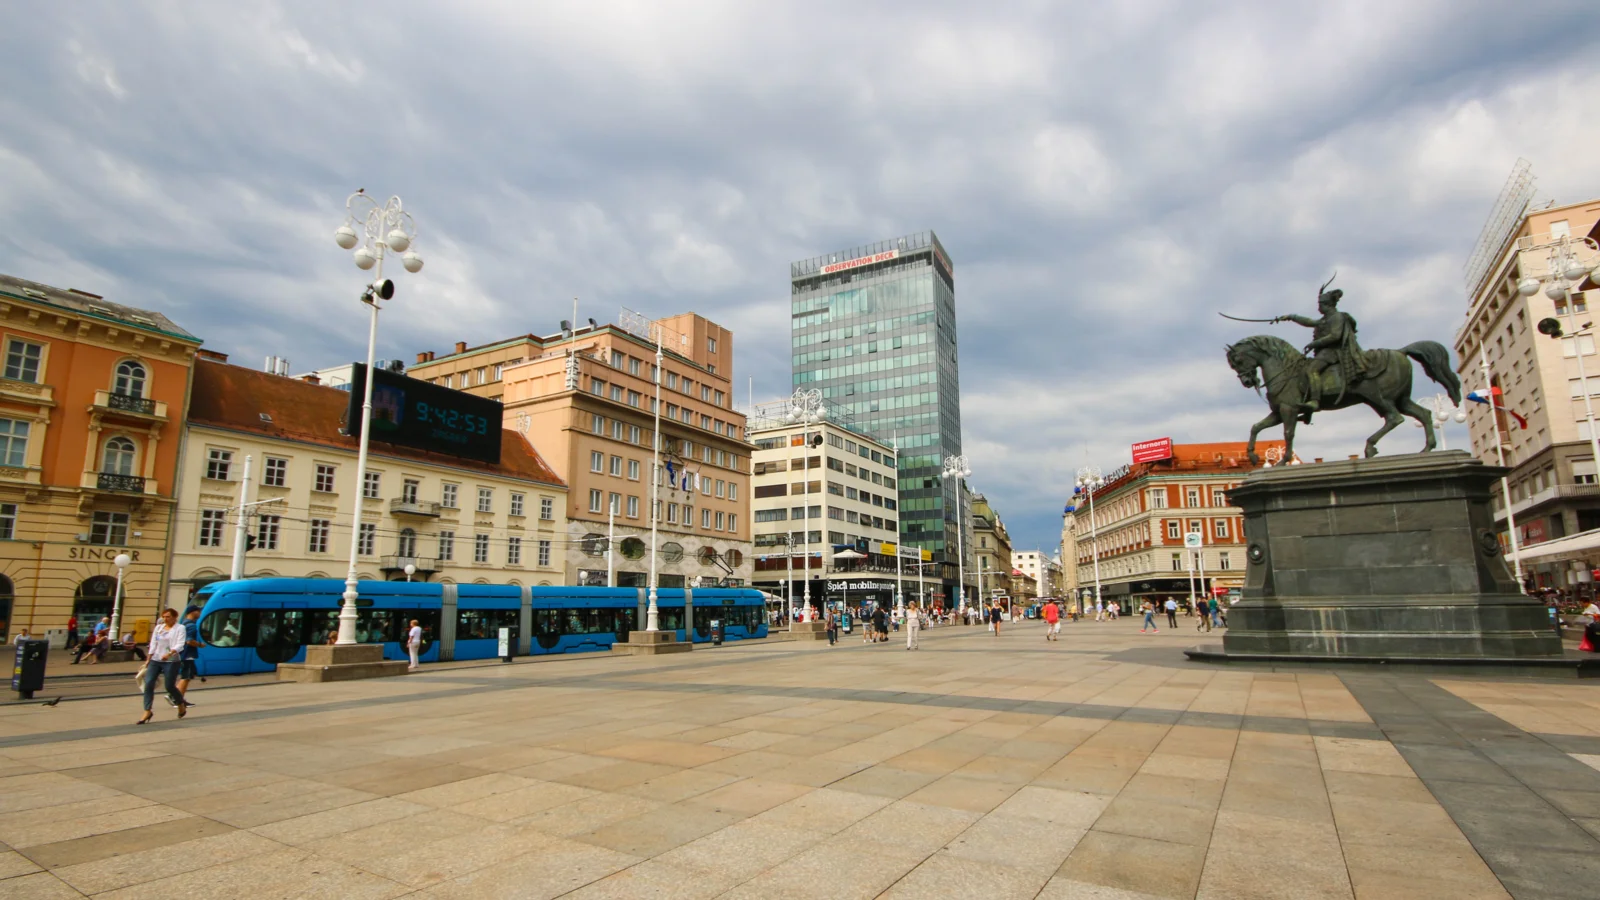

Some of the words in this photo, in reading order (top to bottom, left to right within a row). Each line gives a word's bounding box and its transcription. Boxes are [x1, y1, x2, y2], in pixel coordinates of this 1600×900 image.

[824, 256, 873, 273] OBSERVATION
[875, 251, 894, 262] DECK
[416, 401, 488, 435] 9:42:53
[1132, 440, 1168, 451] Internorm
